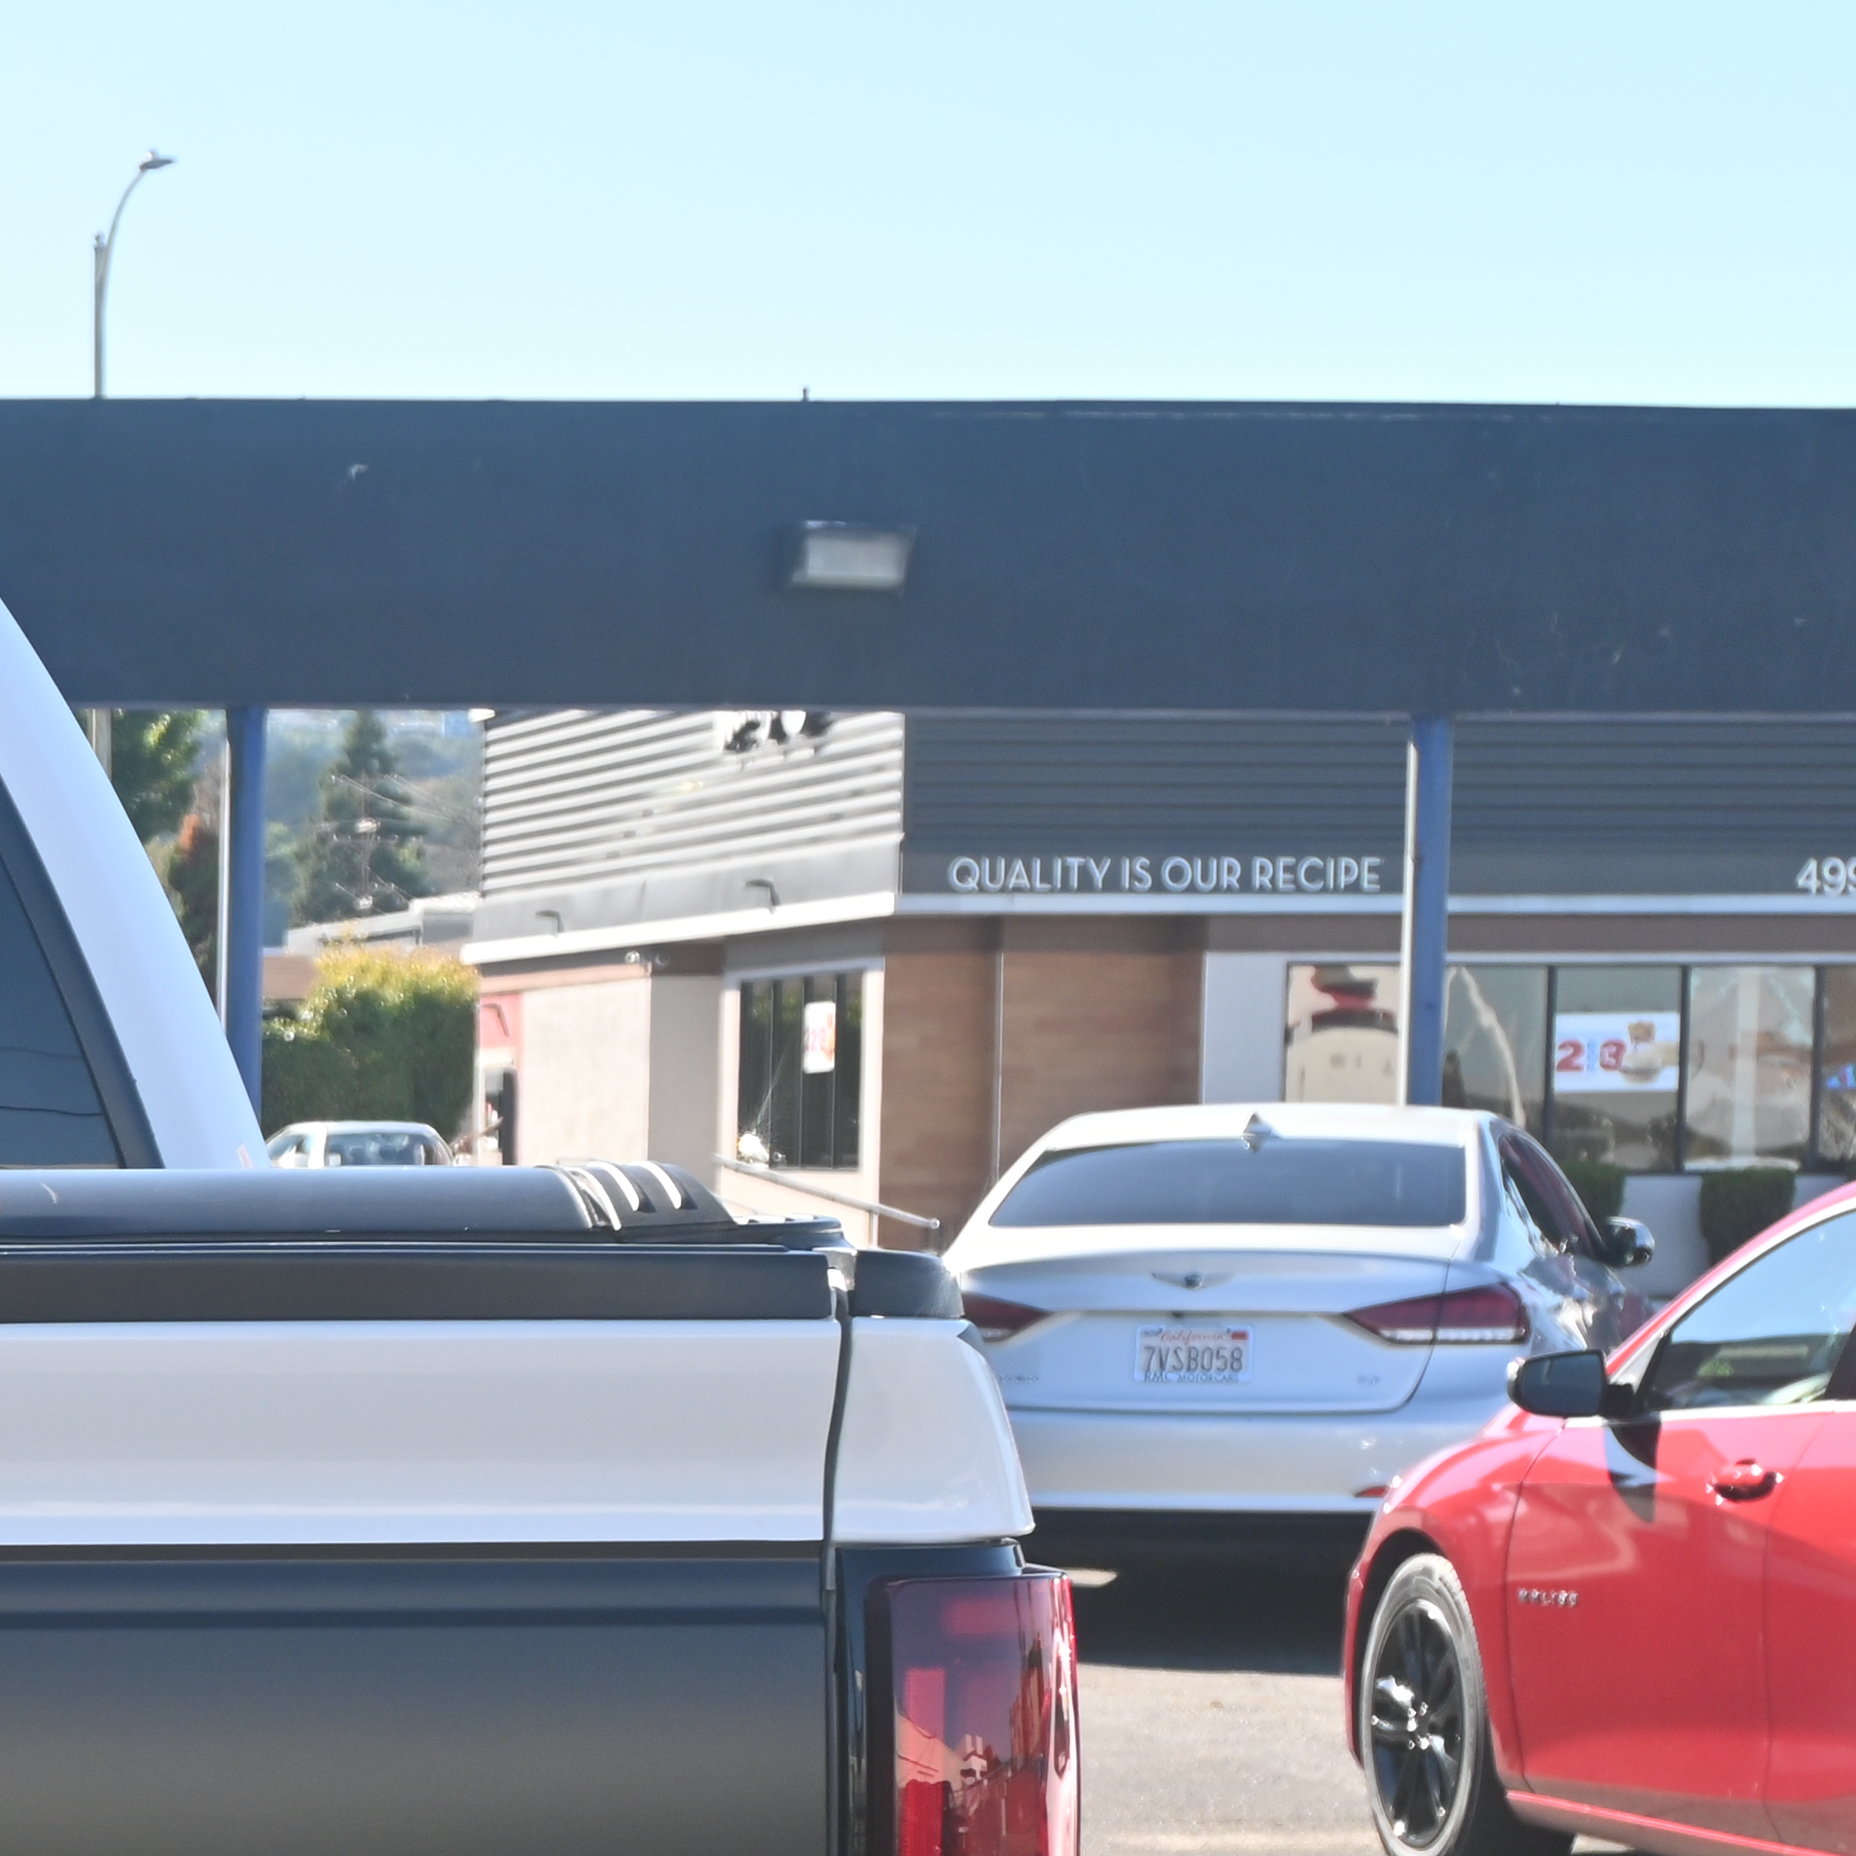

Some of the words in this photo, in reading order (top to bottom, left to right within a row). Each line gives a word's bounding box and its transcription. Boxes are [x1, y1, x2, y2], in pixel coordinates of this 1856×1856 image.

[948, 856, 1111, 892] QUALITY
[1121, 856, 1152, 892] IS
[1161, 856, 1240, 892] OUR
[1251, 856, 1384, 892] RECIPE
[1556, 1040, 1585, 1072] 2
[1144, 1346, 1244, 1373] 7VSB058
[1144, 1371, 1172, 1383] RMC
